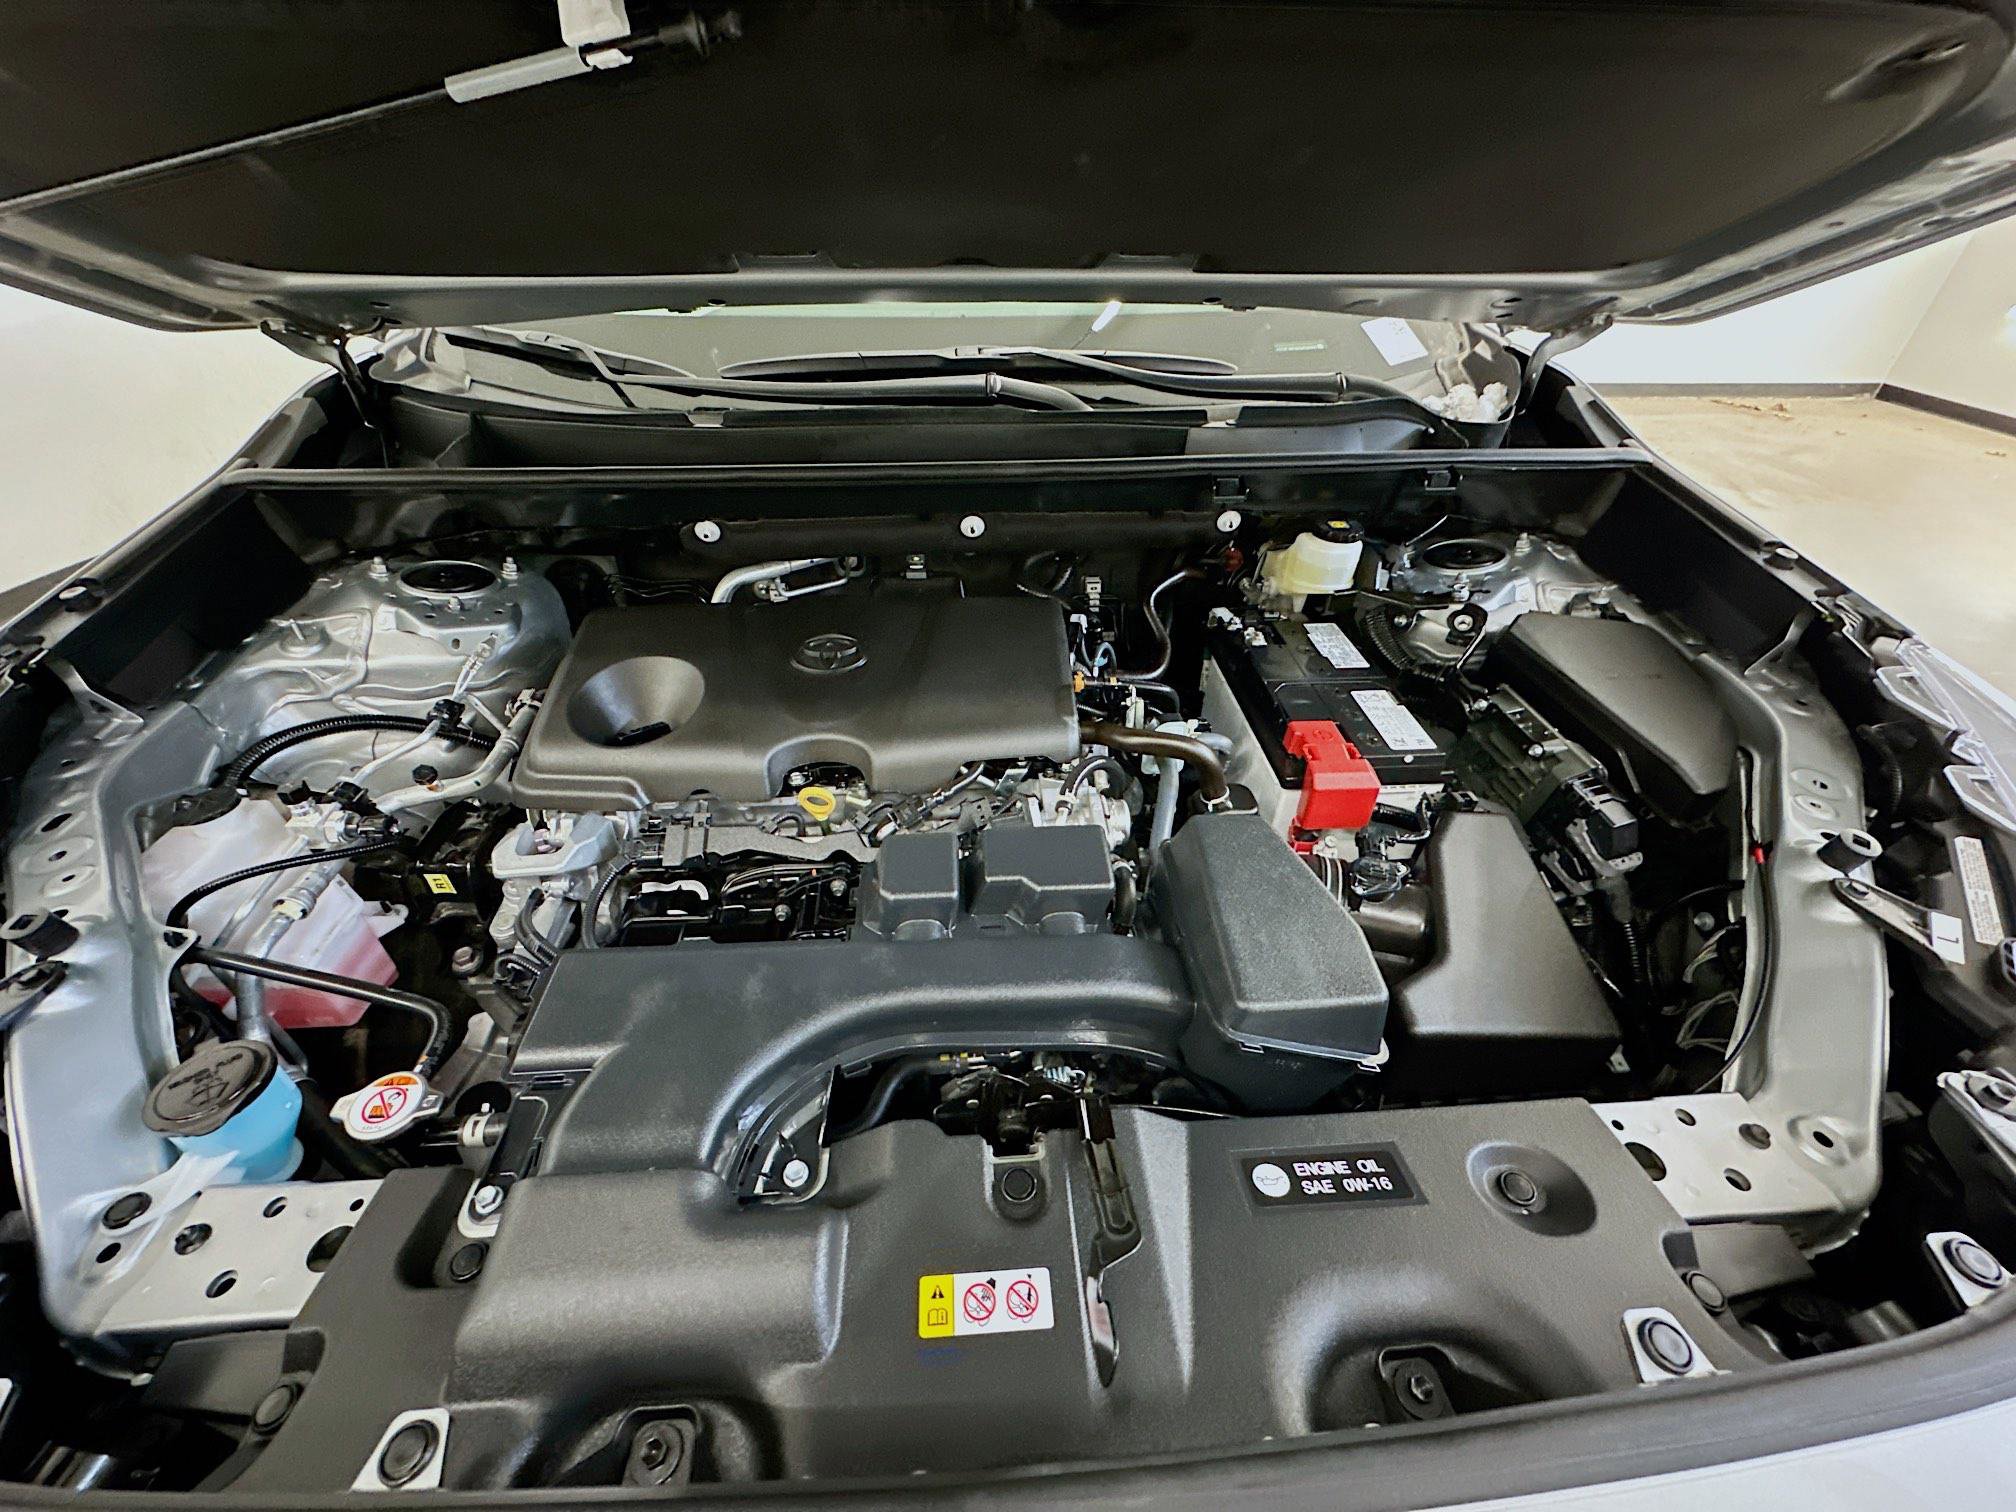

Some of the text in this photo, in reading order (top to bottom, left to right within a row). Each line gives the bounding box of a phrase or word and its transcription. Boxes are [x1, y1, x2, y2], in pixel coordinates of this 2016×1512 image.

[1292, 1159, 1385, 1176] ENGINE OIL
[1300, 1176, 1393, 1195] SAE 0W-16
